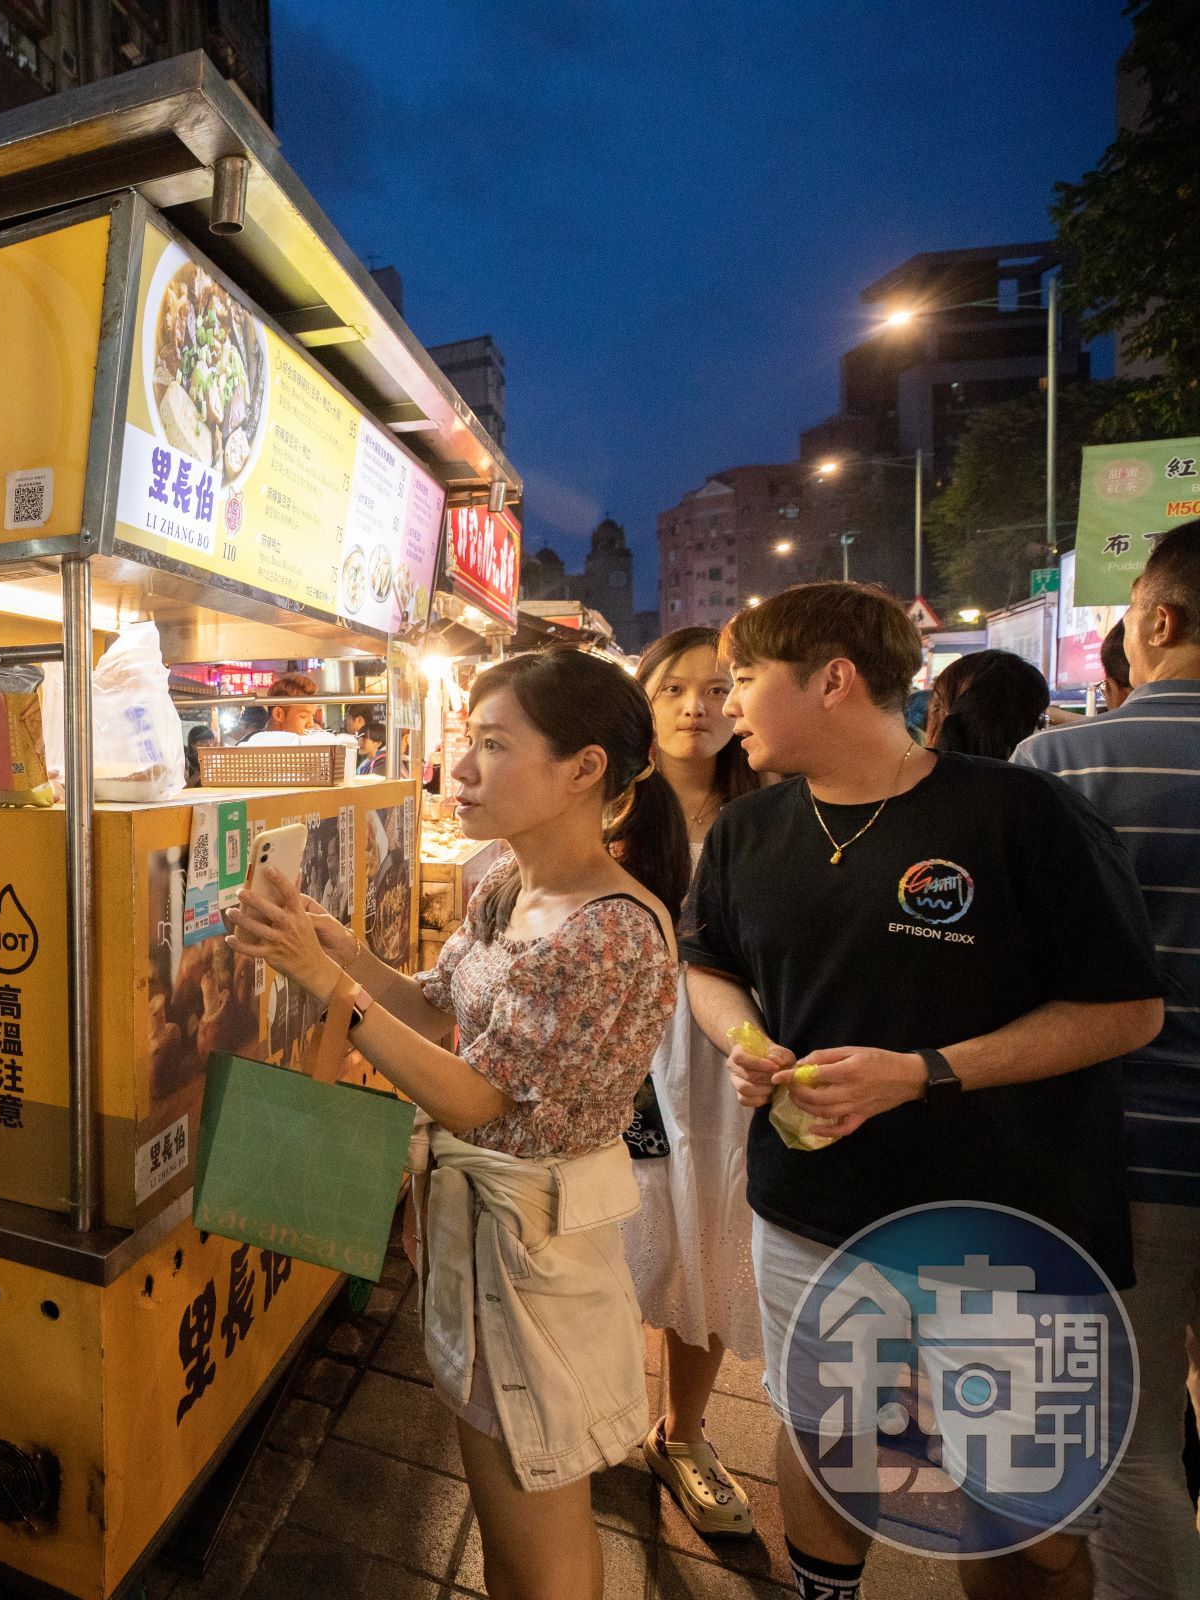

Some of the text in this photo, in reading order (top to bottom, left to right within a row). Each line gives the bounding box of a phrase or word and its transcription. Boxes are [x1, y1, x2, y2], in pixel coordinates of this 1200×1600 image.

[149, 446, 214, 522] 里長伯
[145, 511, 210, 550] LI ZHANG BO
[221, 543, 238, 562] 110
[888, 922, 976, 945] EPTISON 20XX
[150, 1124, 186, 1174] 里長伯
